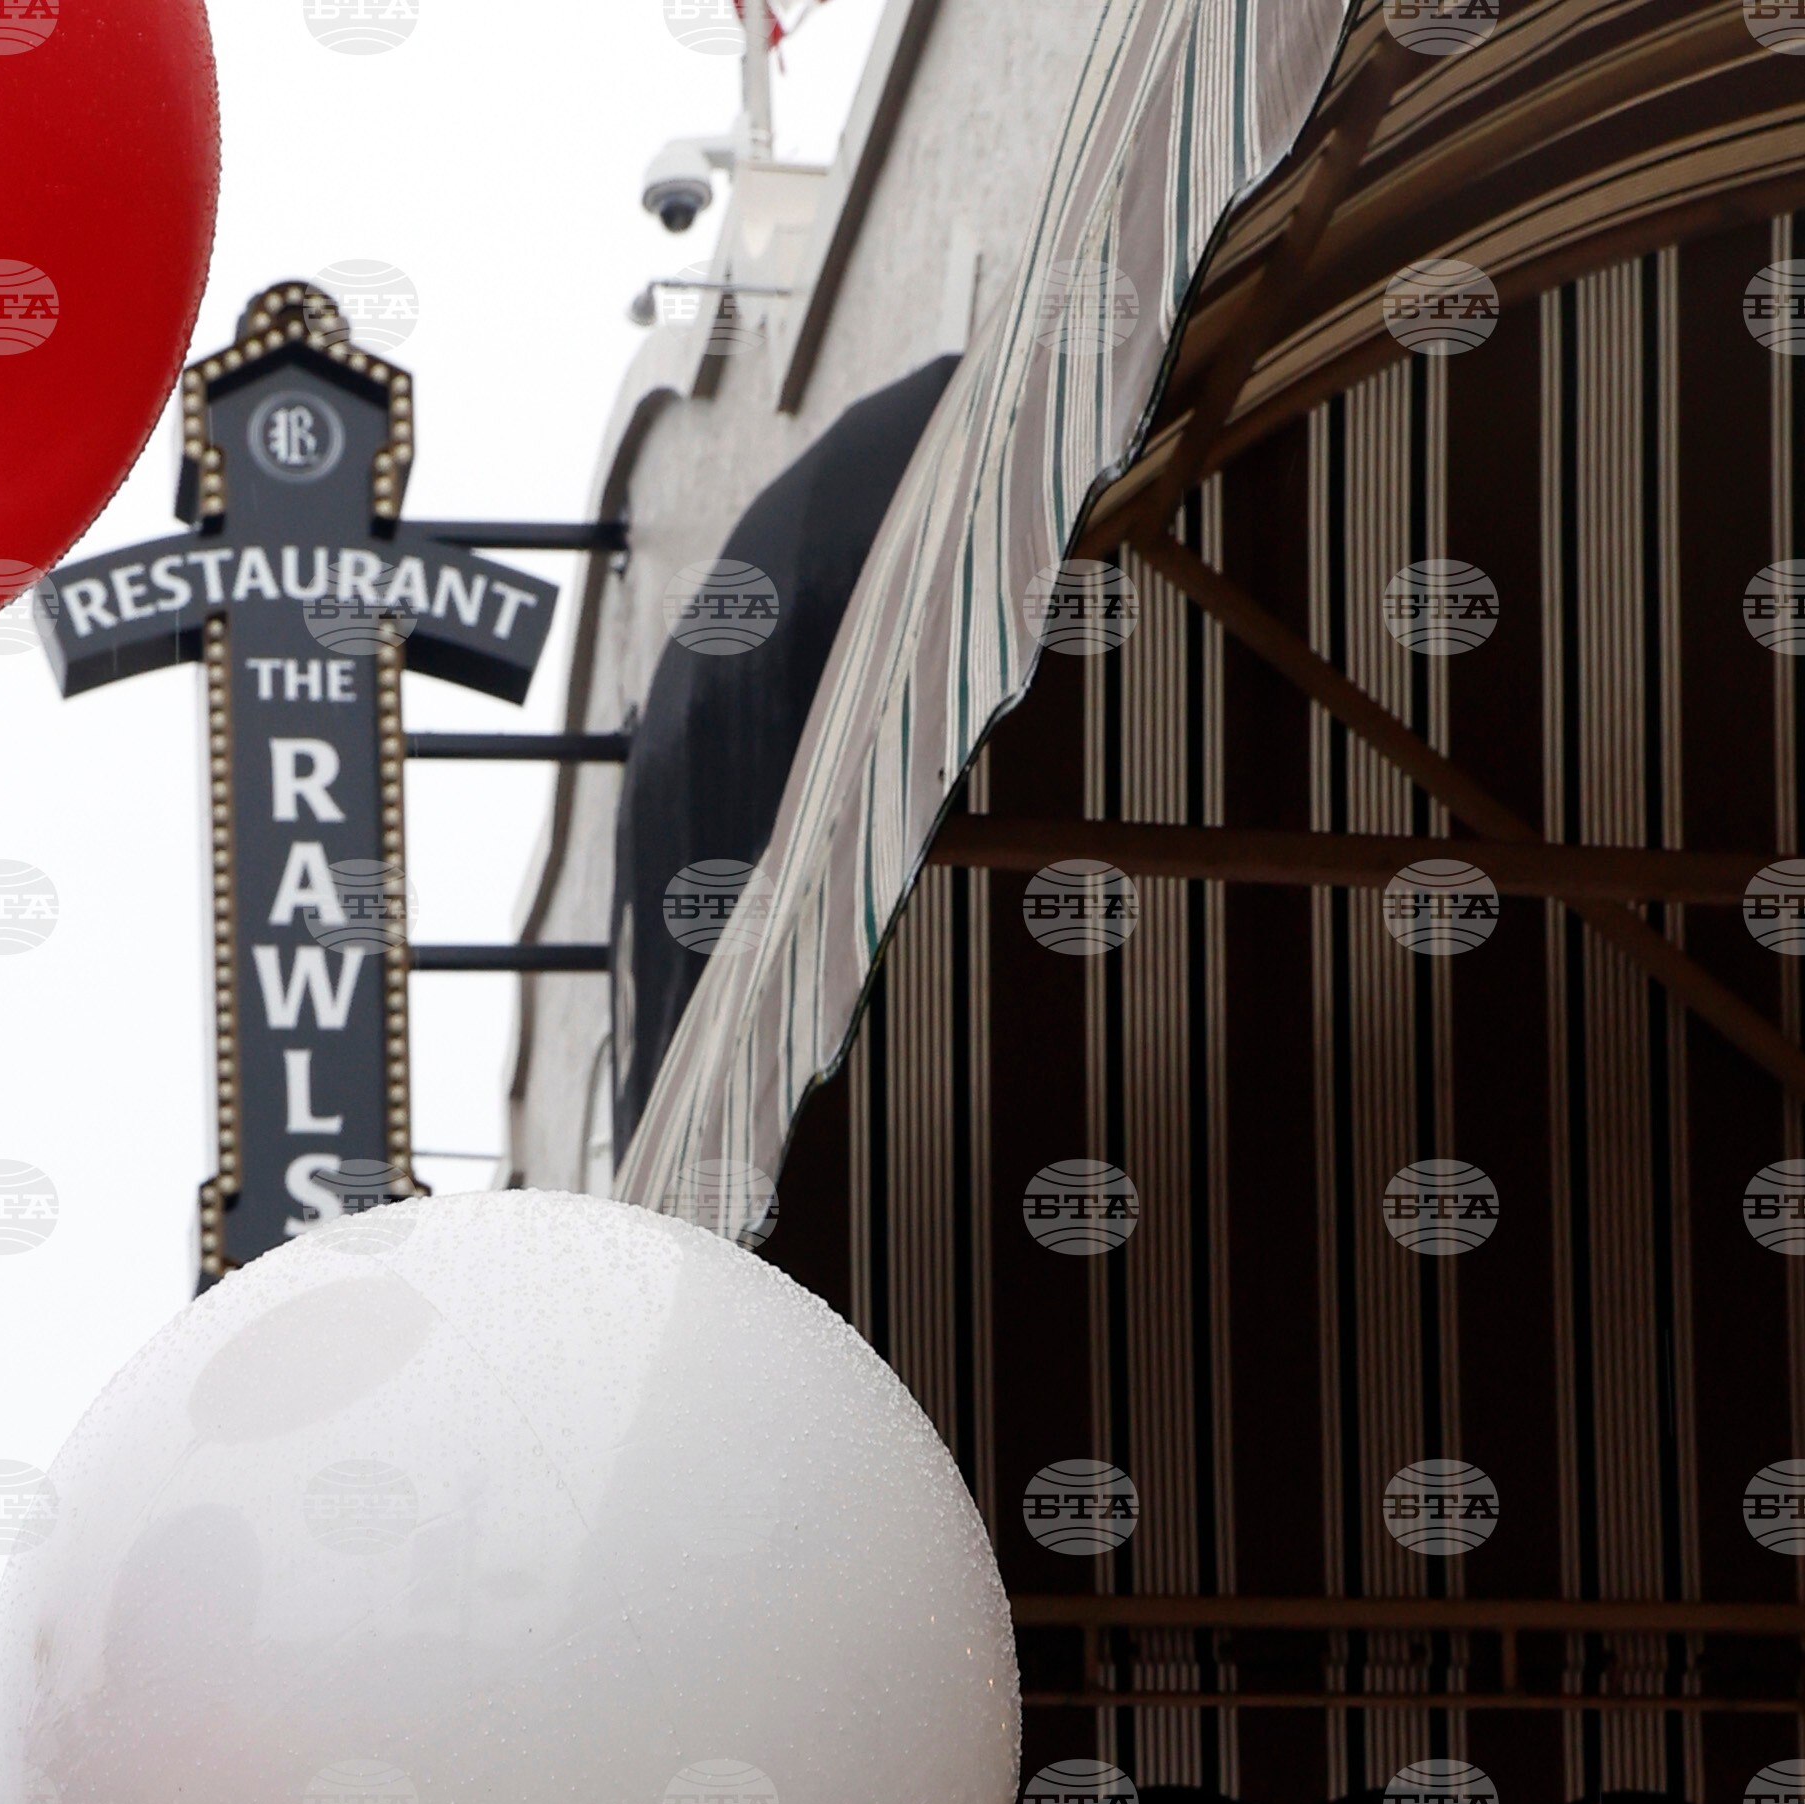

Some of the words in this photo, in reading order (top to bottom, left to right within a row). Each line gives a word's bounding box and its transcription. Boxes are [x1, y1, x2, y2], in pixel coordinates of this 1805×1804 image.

[62, 546, 537, 640] RESTAURANT
[246, 657, 357, 702] THE
[251, 737, 365, 1236] RAWLS
